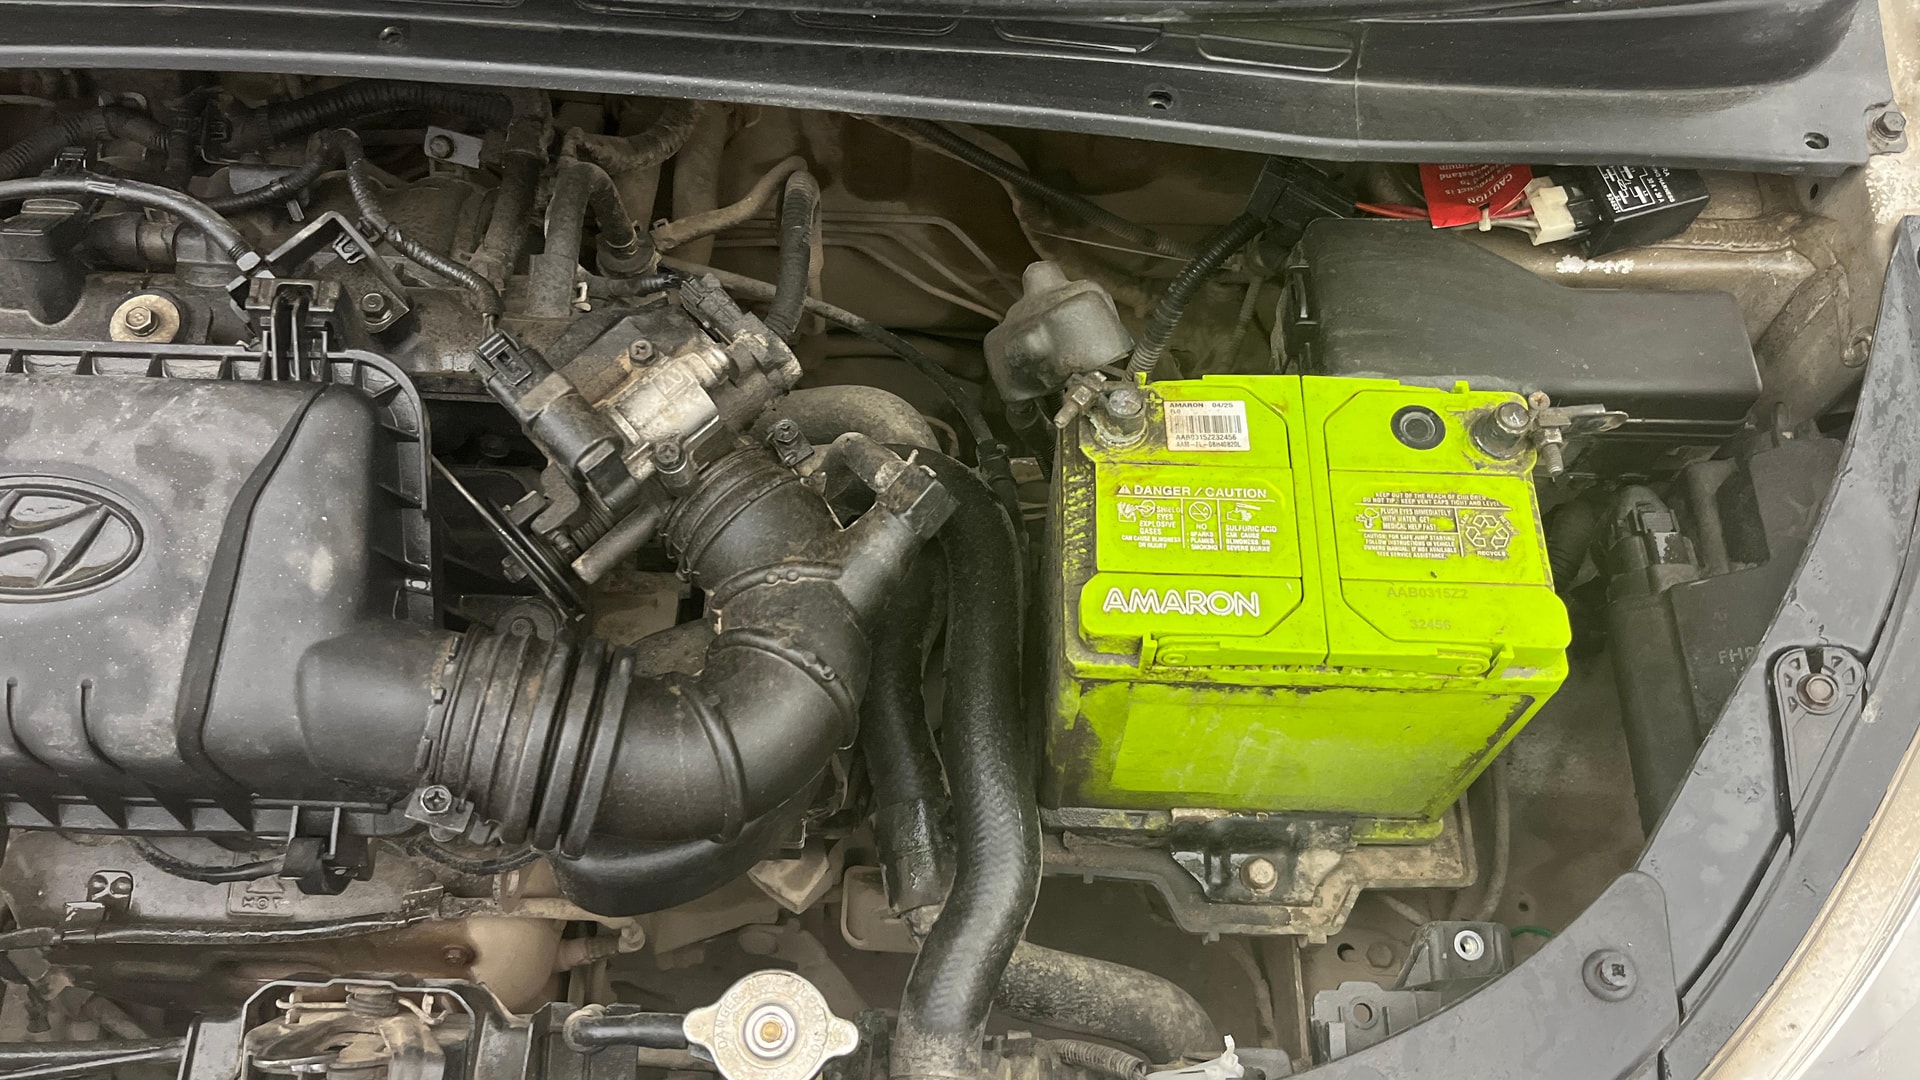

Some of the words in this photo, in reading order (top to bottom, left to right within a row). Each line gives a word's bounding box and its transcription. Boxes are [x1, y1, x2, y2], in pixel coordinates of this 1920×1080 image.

[1440, 164, 1488, 180] withstand
[1457, 174, 1494, 194] product
[1468, 174, 1512, 203] CAUTION
[1134, 484, 1191, 496] DANGER
[1194, 487, 1203, 496] /
[1205, 487, 1267, 498] CAUTION
[1139, 520, 1176, 528] EXPLOSIVE
[1140, 527, 1162, 535] GASES
[1225, 524, 1259, 532] SULFURIC
[1103, 587, 1260, 617] AMARON
[1410, 619, 1452, 630] 32456
